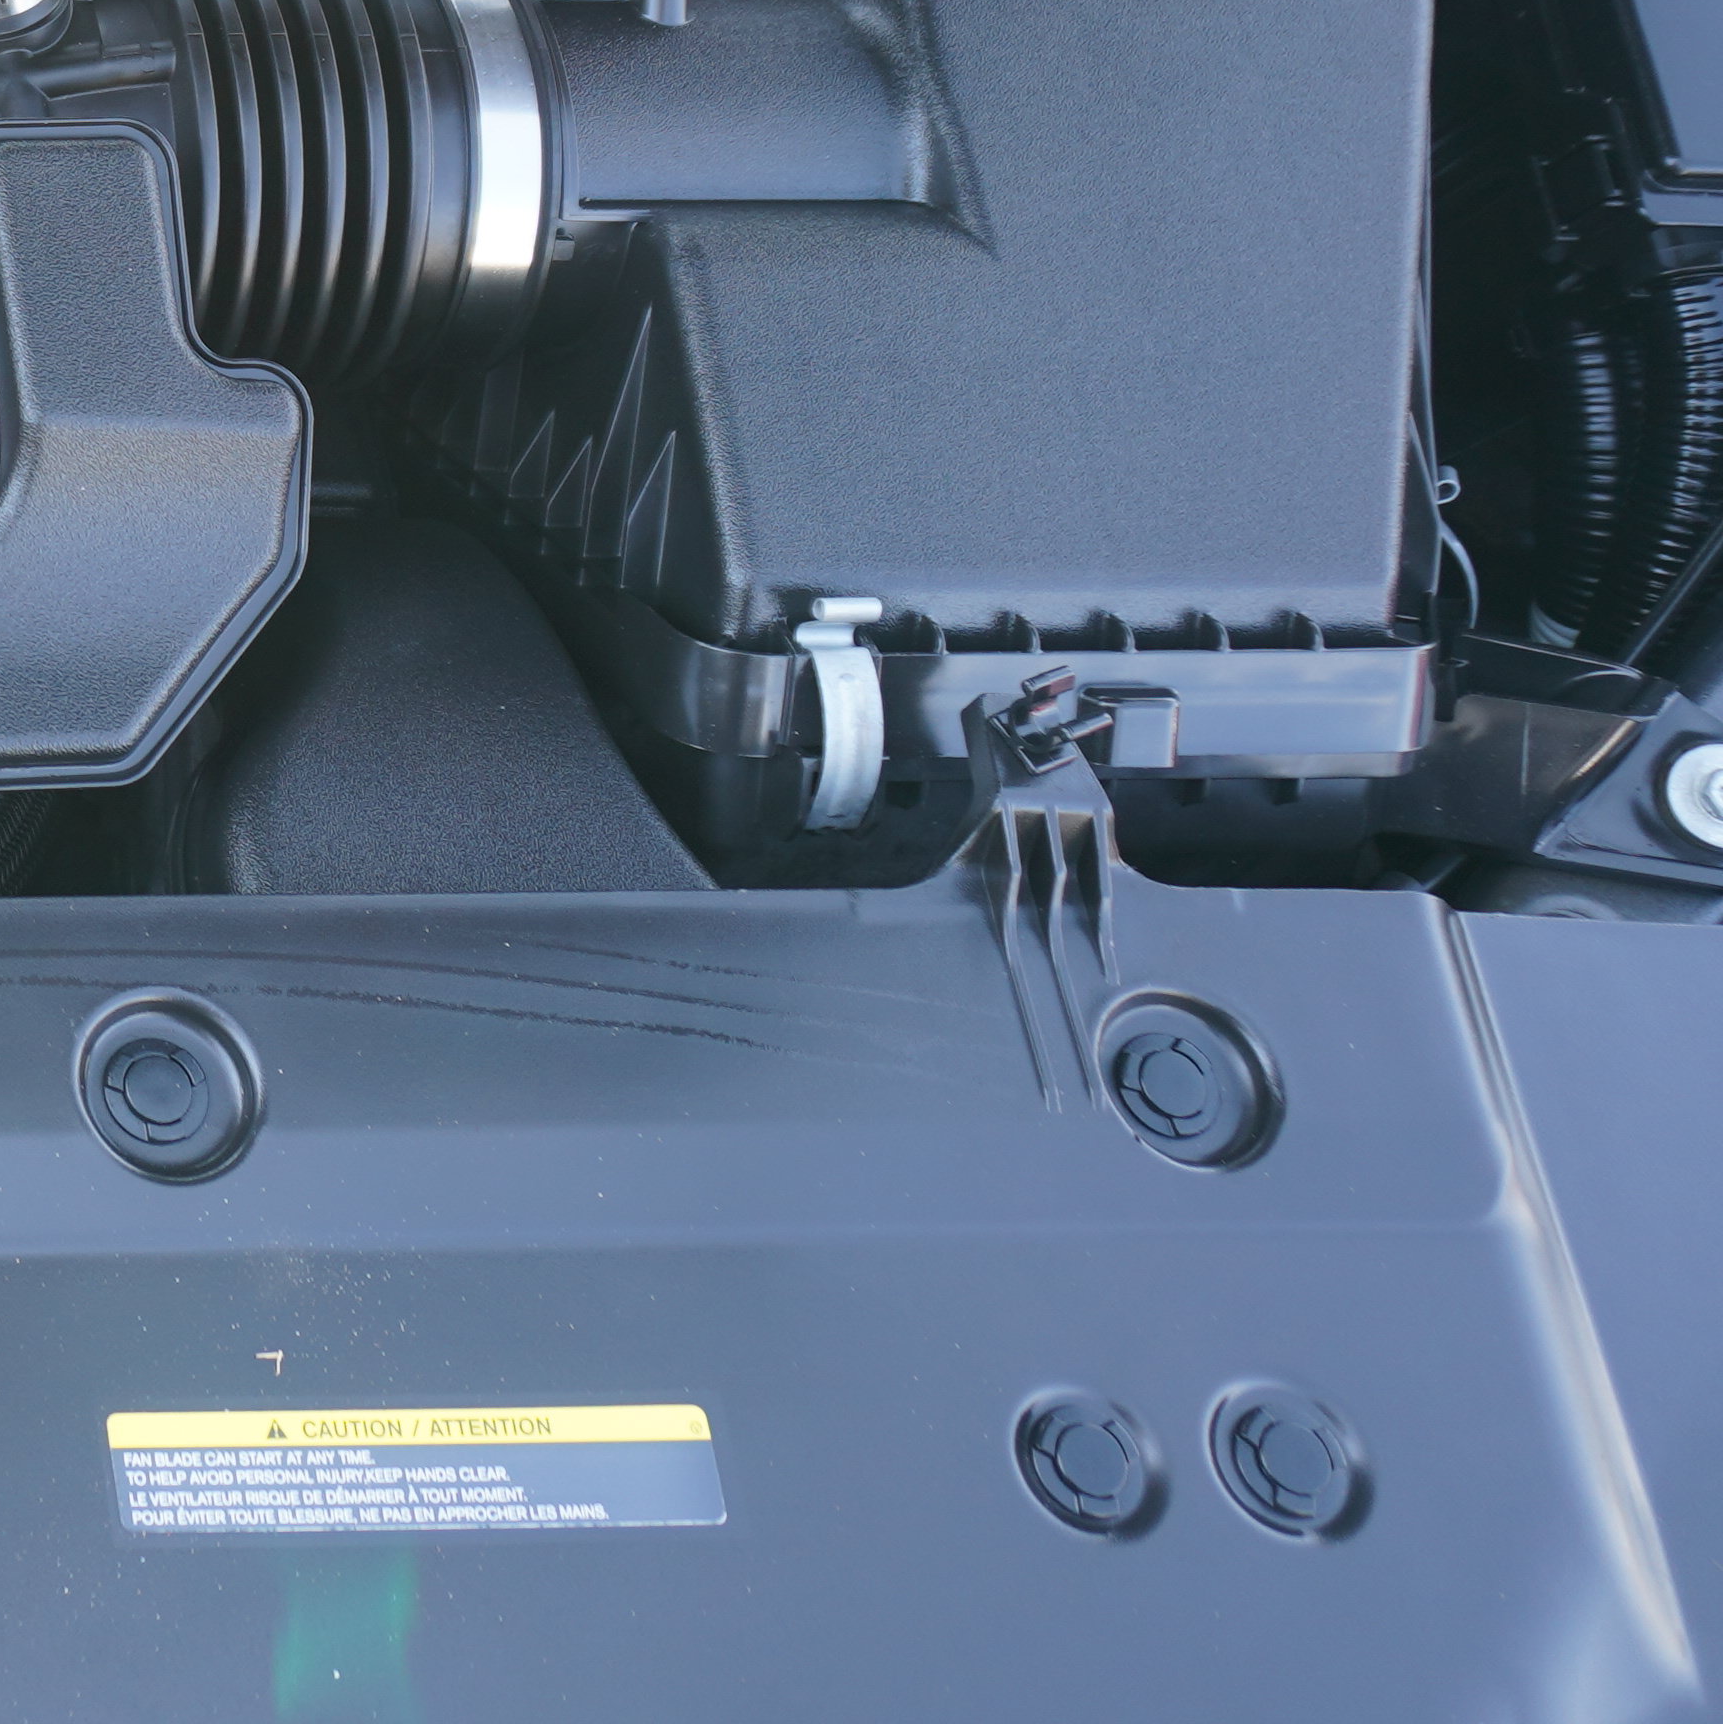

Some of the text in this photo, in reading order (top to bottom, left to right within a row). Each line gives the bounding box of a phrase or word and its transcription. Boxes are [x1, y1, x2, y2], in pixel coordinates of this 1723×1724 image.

[302, 1419, 403, 1439] CAUTION
[430, 1417, 552, 1437] ATTENTION
[124, 1449, 376, 1467] FAN BLADE CAN START AT ANY TIME.
[126, 1471, 147, 1486] TO
[150, 1470, 187, 1487] HELP
[190, 1470, 234, 1486] AVOID
[236, 1469, 314, 1485] PERSONAL
[406, 1466, 457, 1483] HANDS
[460, 1465, 510, 1482] CLEAR.
[129, 1484, 528, 1507] LE VENTILATEUR RISQUE DE DÉMARRER À TOUT MOMENT.
[132, 1503, 610, 1526] POUR ÉVITER TOUTE BLESSURE, NE PAS EN APPROCHER LES MAINS.
